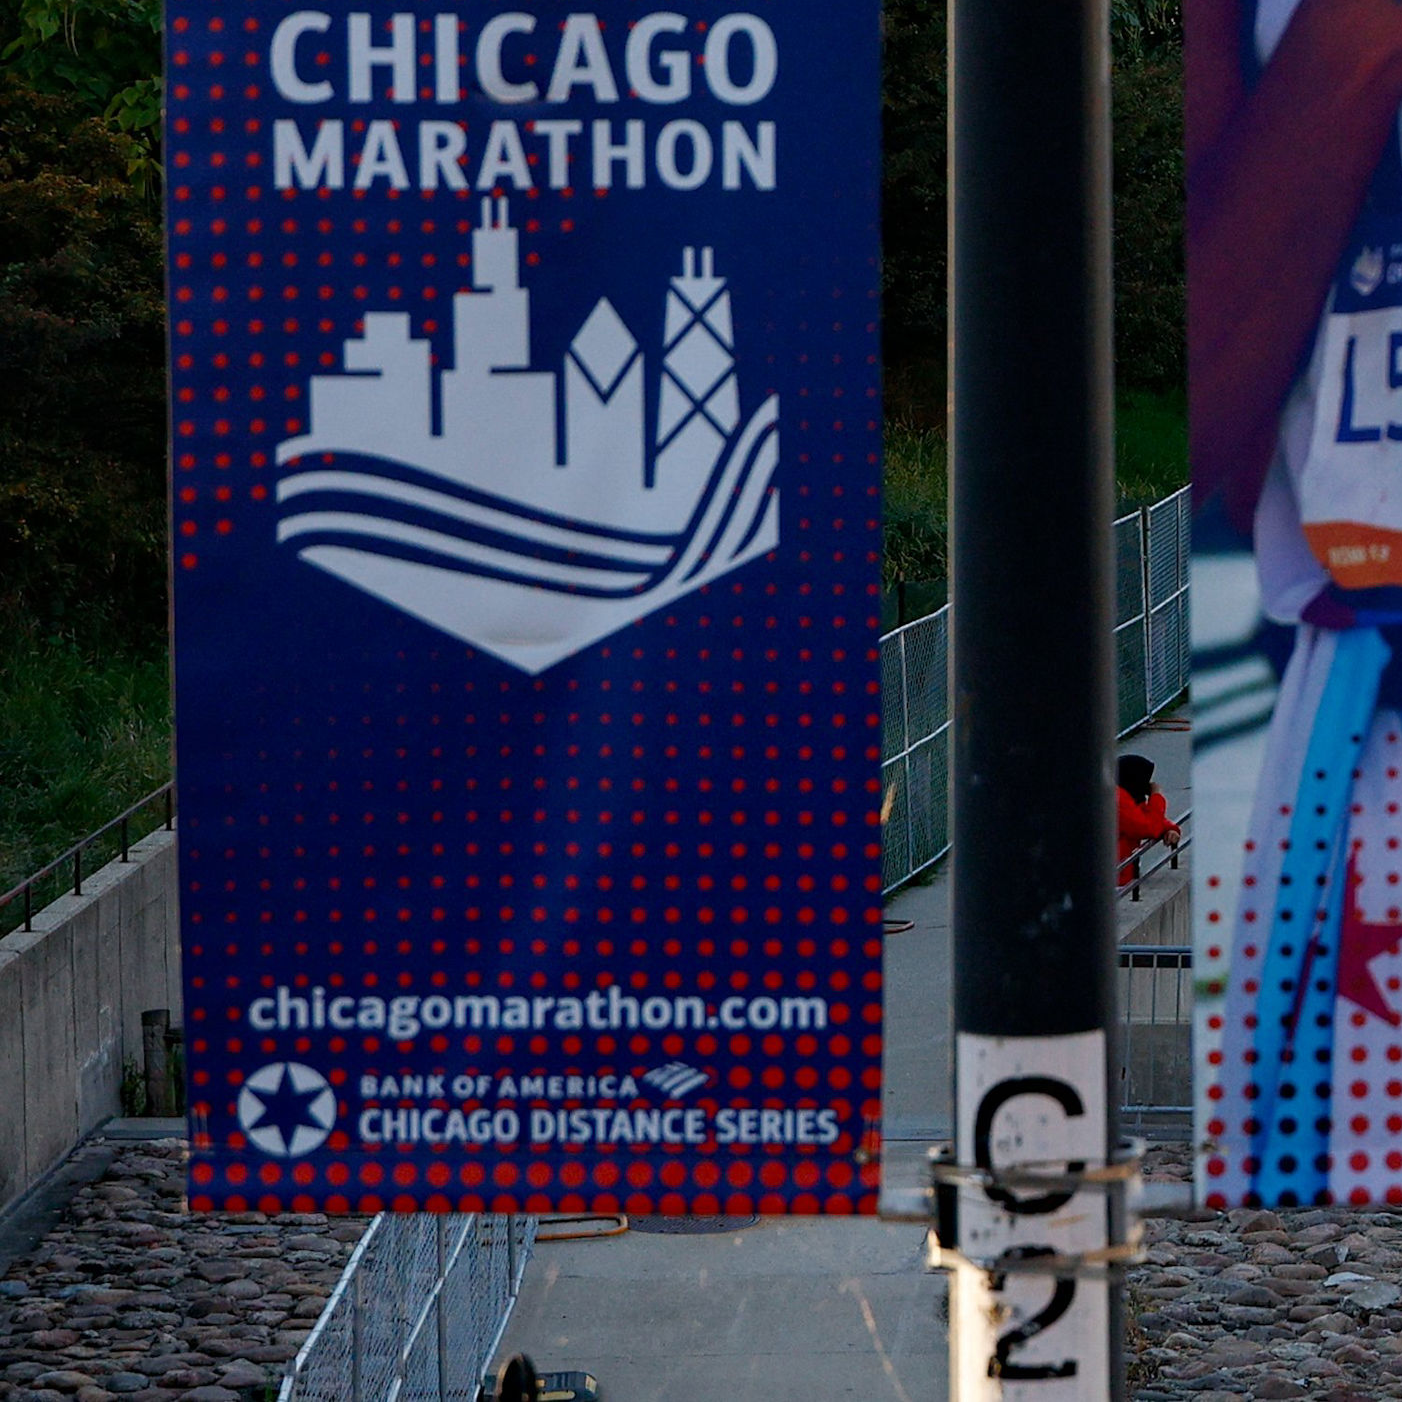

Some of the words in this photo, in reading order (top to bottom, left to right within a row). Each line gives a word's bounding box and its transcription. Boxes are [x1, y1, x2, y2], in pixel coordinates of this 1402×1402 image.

[269, 9, 779, 105] CHICAGO
[273, 119, 778, 191] MARATHON
[248, 985, 828, 1039] chicagomarathon.com
[360, 1074, 444, 1098] BANK
[452, 1074, 492, 1098] OF
[499, 1074, 640, 1098] AMERICA
[358, 1108, 520, 1144] CHICAGO
[531, 1108, 705, 1144] DISTANCE
[716, 1108, 840, 1144] SERIES
